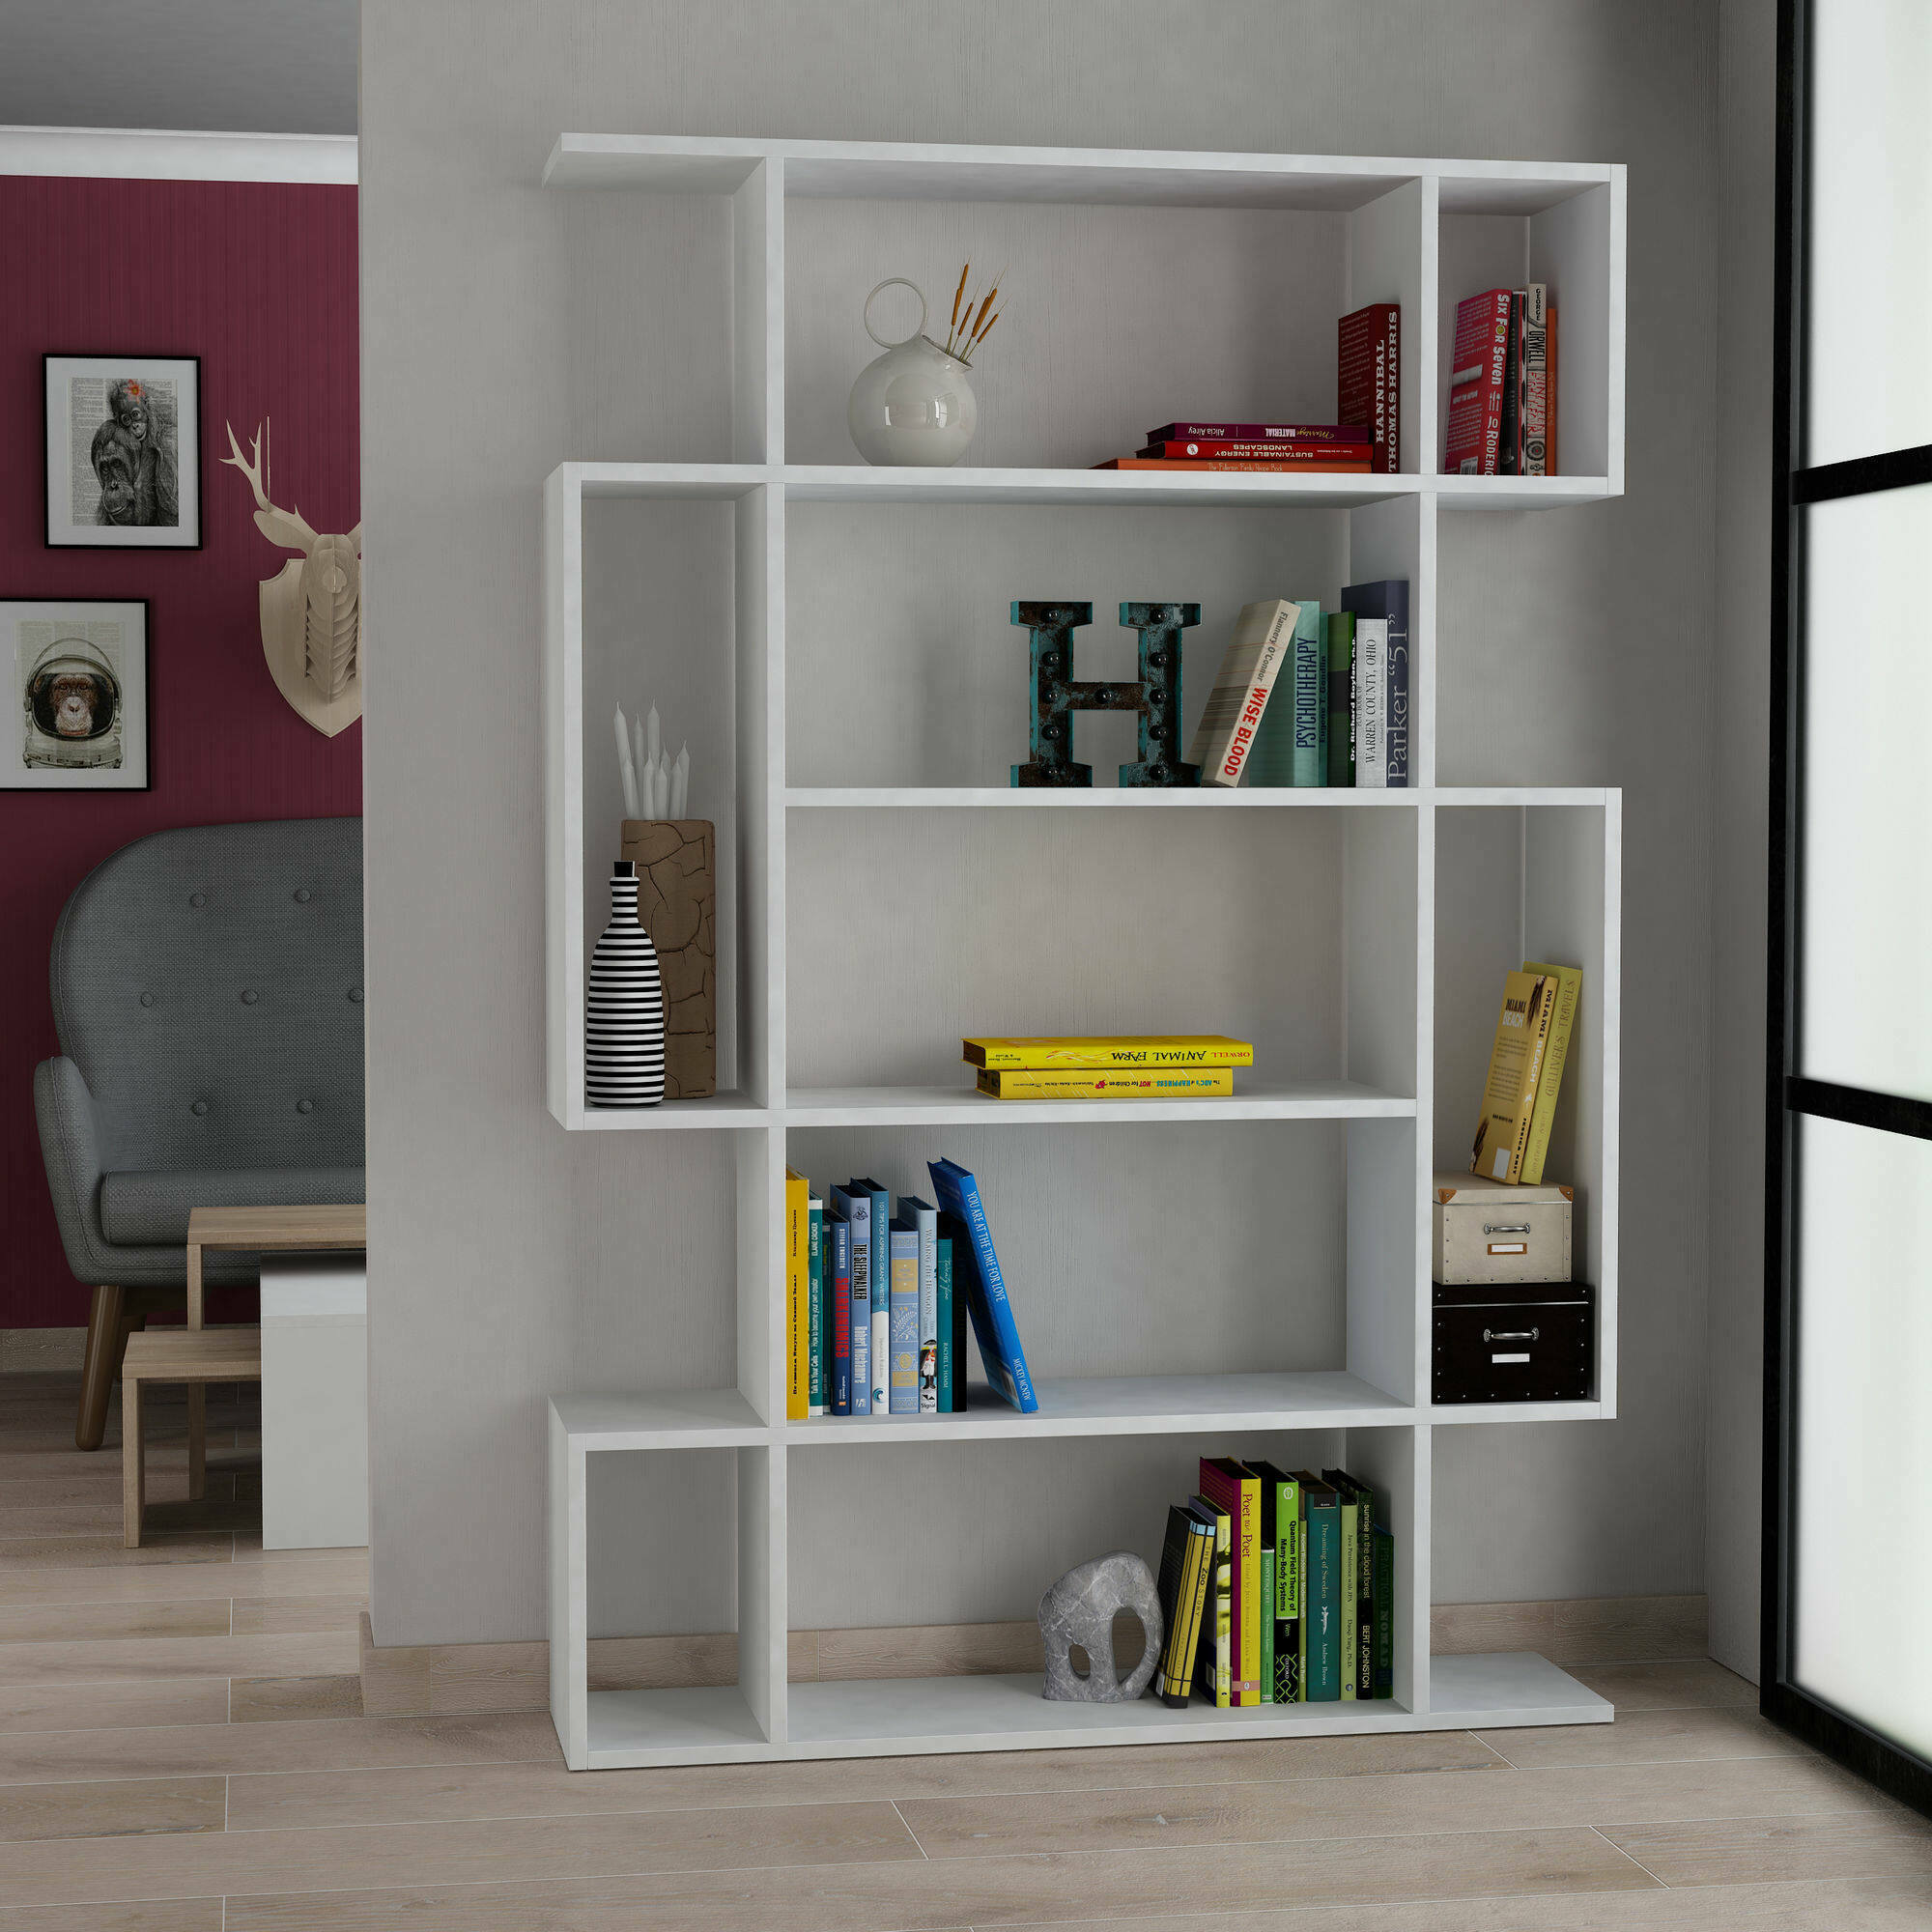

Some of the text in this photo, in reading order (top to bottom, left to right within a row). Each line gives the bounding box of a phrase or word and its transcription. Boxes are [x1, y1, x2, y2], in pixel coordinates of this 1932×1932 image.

[1528, 330, 1546, 363] ORWELL
[1376, 340, 1385, 443] HANNIBAL
[1388, 311, 1397, 472] THOMAS HARRIS
[1188, 426, 1225, 437] Alicia Airey
[1265, 428, 1296, 438] MATERIAL
[1257, 611, 1289, 682] Flannery O'Connor
[1010, 601, 1202, 787] H
[1296, 637, 1318, 749] PSYCHOTHERAPY
[1365, 639, 1378, 763] WARREN COUNTY, OHIO
[1224, 687, 1267, 776] WISE BLOOD
[1387, 685, 1406, 780] Parker
[1502, 1011, 1524, 1029] BEACH
[1506, 999, 1526, 1015] MIAMI
[1558, 980, 1576, 1030] TRAVELS
[1530, 989, 1552, 1083] MIAMI BEACH
[1111, 1051, 1147, 1062] FARM
[1152, 1050, 1207, 1061] ANIMAL
[967, 1190, 1005, 1302] YOU ARE AT THE TIME FOR LOVE
[853, 1243, 867, 1300] THE SLEEPWALKER
[835, 1277, 849, 1358] SHARKONOMICS
[854, 1326, 867, 1347] Robert
[1012, 1357, 1025, 1378] MICKEY
[1242, 1492, 1253, 1558] Poet Poet
[1289, 1520, 1297, 1555] Quantum
[1320, 1523, 1329, 1559] Dreaming
[1202, 1545, 1211, 1562] THE
[1321, 1561, 1329, 1570] of
[1363, 1555, 1372, 1576] cloud
[1279, 1538, 1288, 1611] Many-Body Systems
[1289, 1577, 1297, 1601] Theory
[1363, 1577, 1372, 1599] forest
[1194, 1588, 1204, 1617] STORY
[1290, 1603, 1297, 1611] of
[1379, 1610, 1389, 1667] NOMAD
